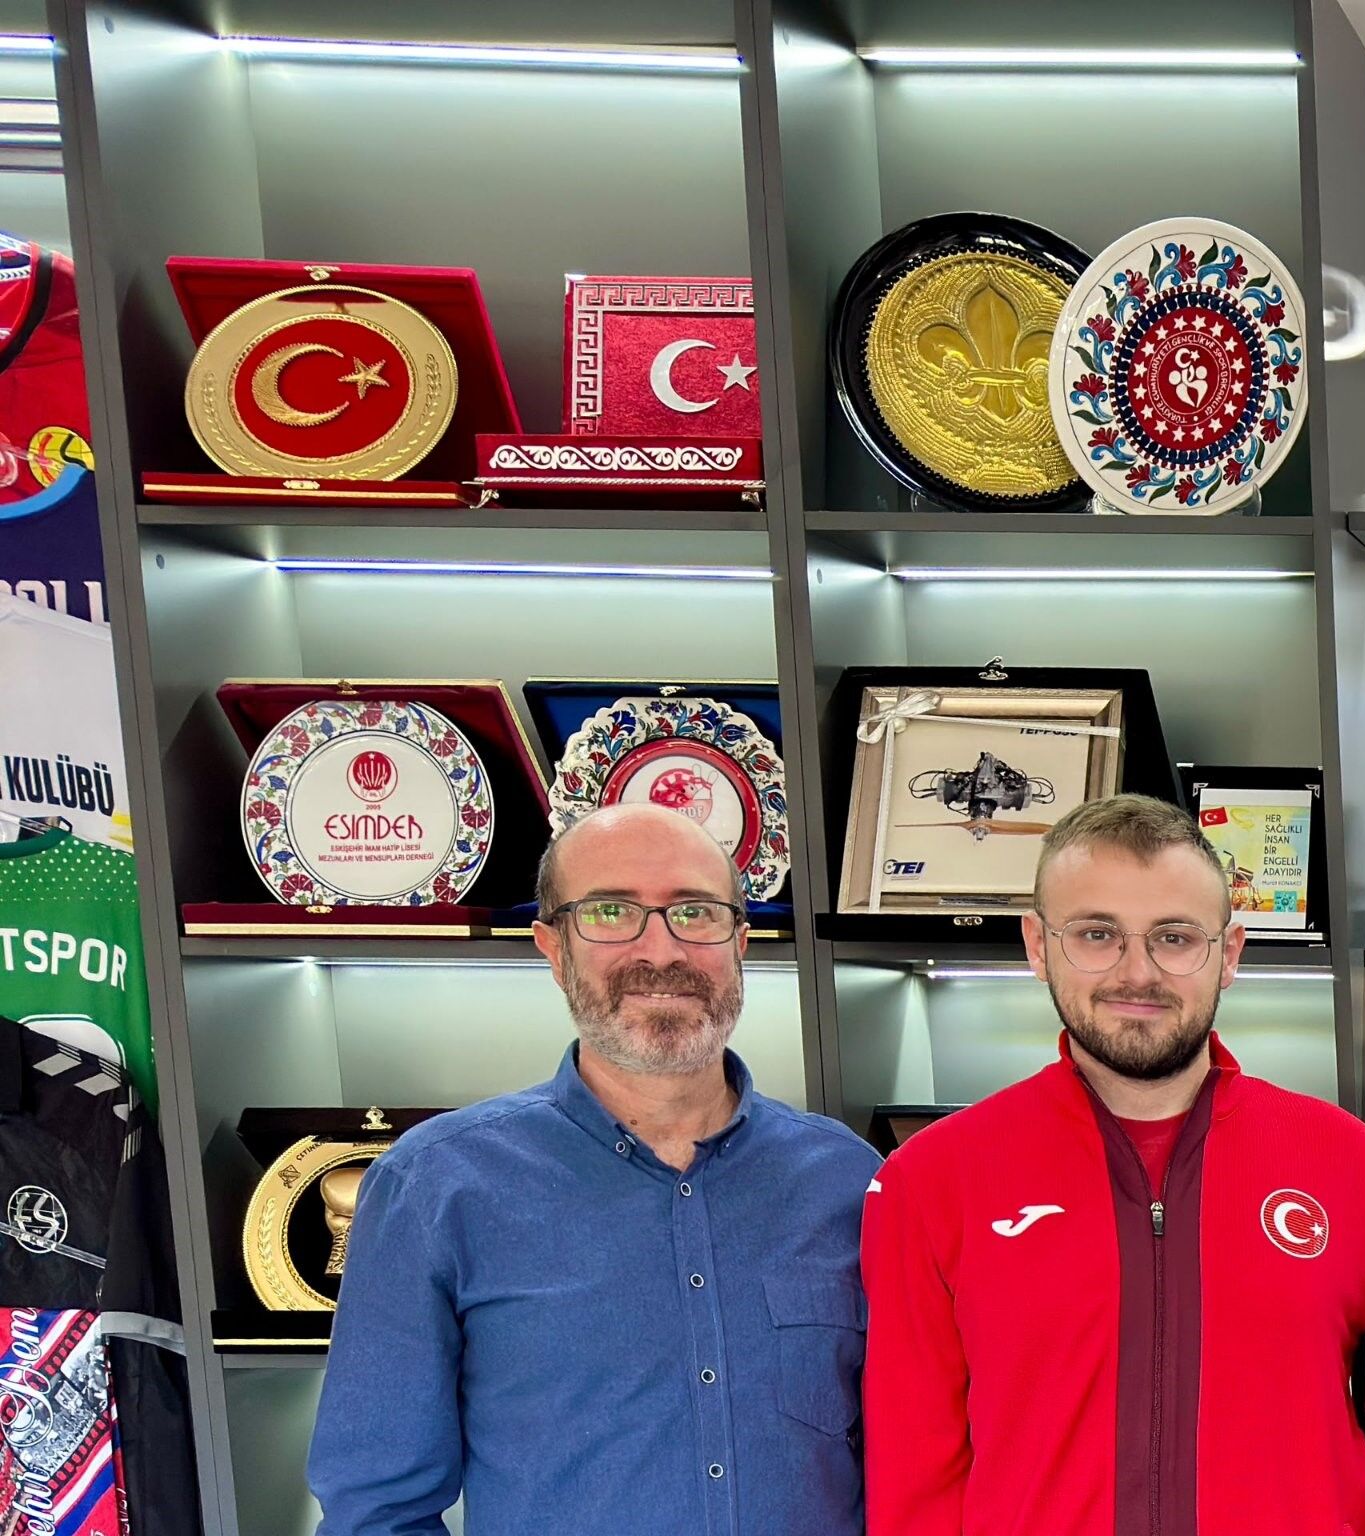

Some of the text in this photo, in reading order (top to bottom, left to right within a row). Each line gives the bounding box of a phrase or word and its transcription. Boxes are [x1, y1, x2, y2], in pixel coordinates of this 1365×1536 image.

[4, 753, 115, 817] KULÜBÜ
[1265, 814, 1282, 823] HER
[1264, 823, 1303, 834] SAĞLIKLI
[1264, 834, 1290, 844] İNSAN
[1264, 845, 1277, 855] BİR
[1263, 855, 1299, 866] ENGELLİ
[893, 861, 926, 875] TEI
[1262, 867, 1302, 877] ADAYIDIR
